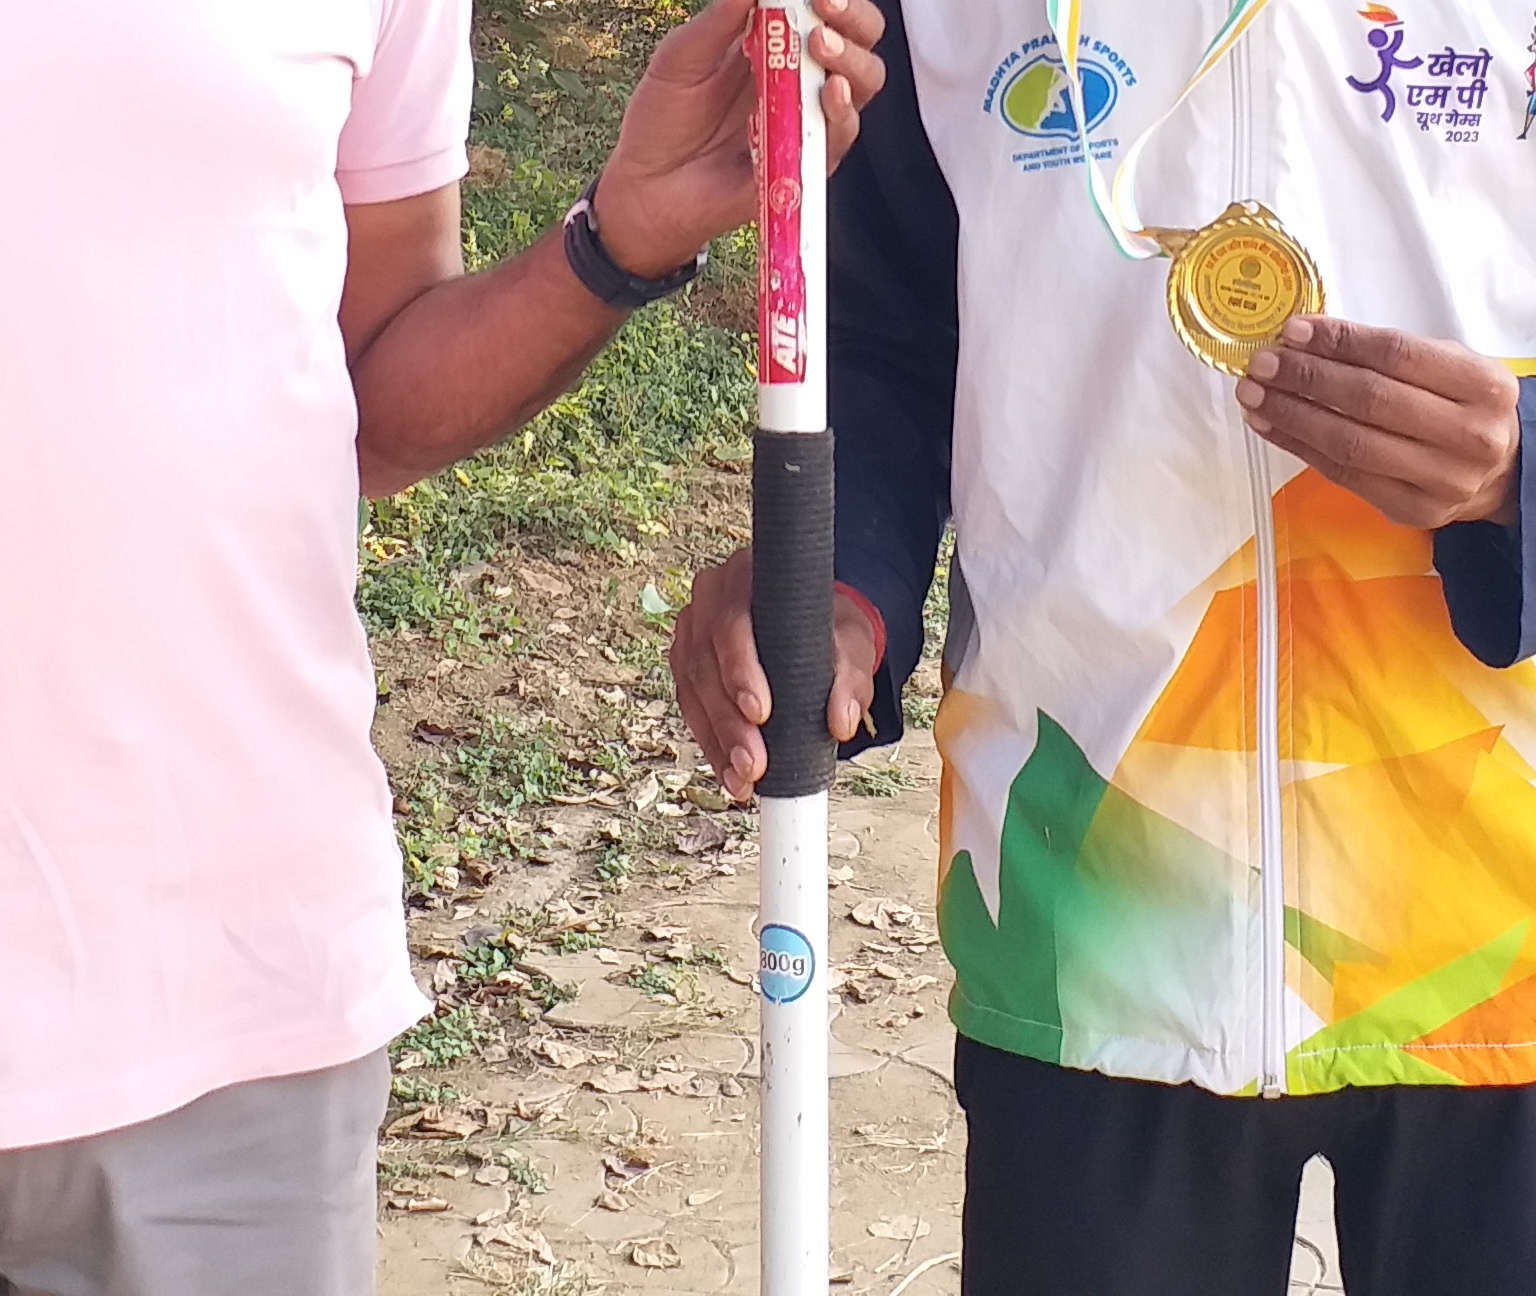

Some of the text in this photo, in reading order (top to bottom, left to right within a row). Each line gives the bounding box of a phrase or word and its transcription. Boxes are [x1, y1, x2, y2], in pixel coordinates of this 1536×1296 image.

[767, 19, 786, 70] 800
[983, 33, 1137, 113] MADHYA PRAH SPORTS
[1427, 46, 1493, 78] खेलो
[1407, 78, 1488, 109] एम पी
[1417, 109, 1482, 131] यूथ गेम्स
[1012, 138, 1119, 162] DEPARTMENT OF PORTS
[1445, 130, 1480, 143] 2023
[1023, 161, 1041, 172] AND
[1073, 151, 1113, 165] WEARE
